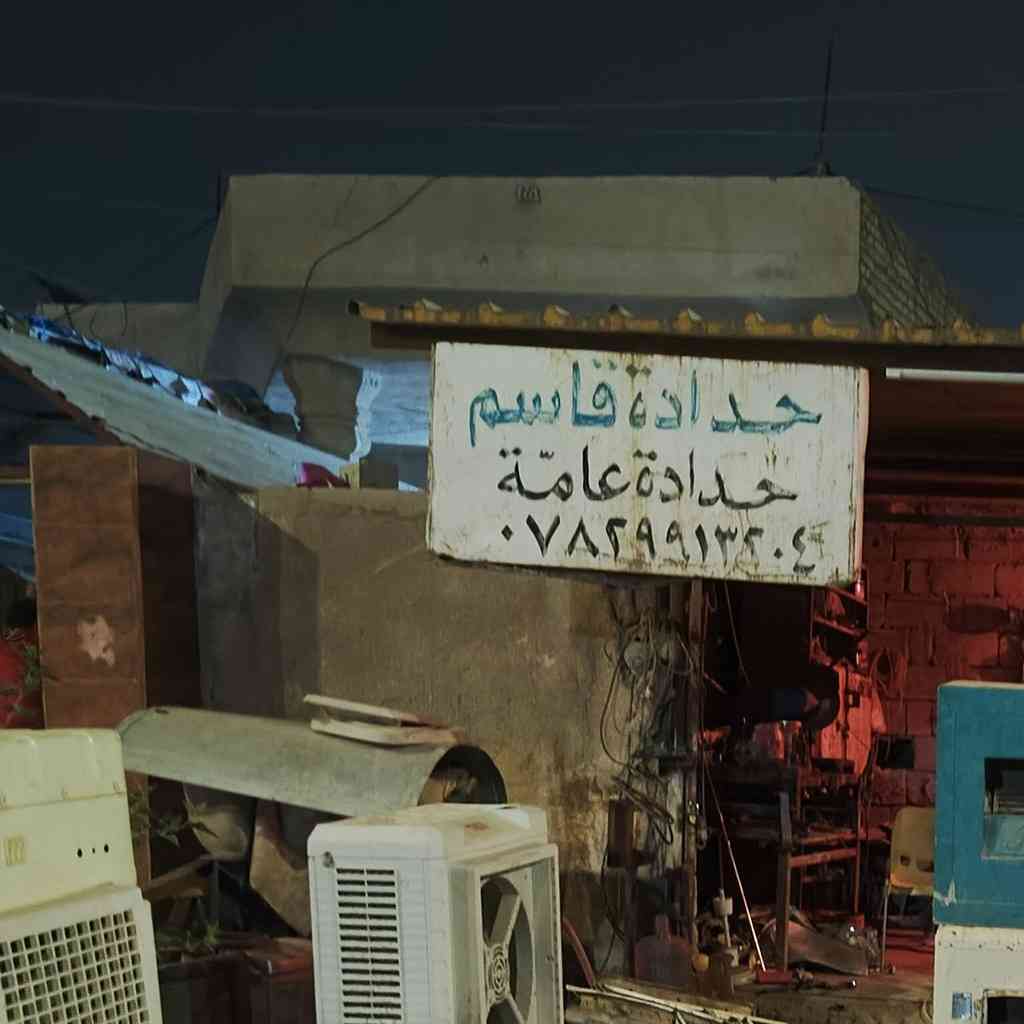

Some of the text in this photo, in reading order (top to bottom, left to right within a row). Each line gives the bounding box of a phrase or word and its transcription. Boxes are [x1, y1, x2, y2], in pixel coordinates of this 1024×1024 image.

[469, 359, 822, 448] حدادة قاسم
[633, 447, 798, 510] حدادة
[501, 513, 817, 574] ٠٧٨٢٩٩١٣٢٠٤
